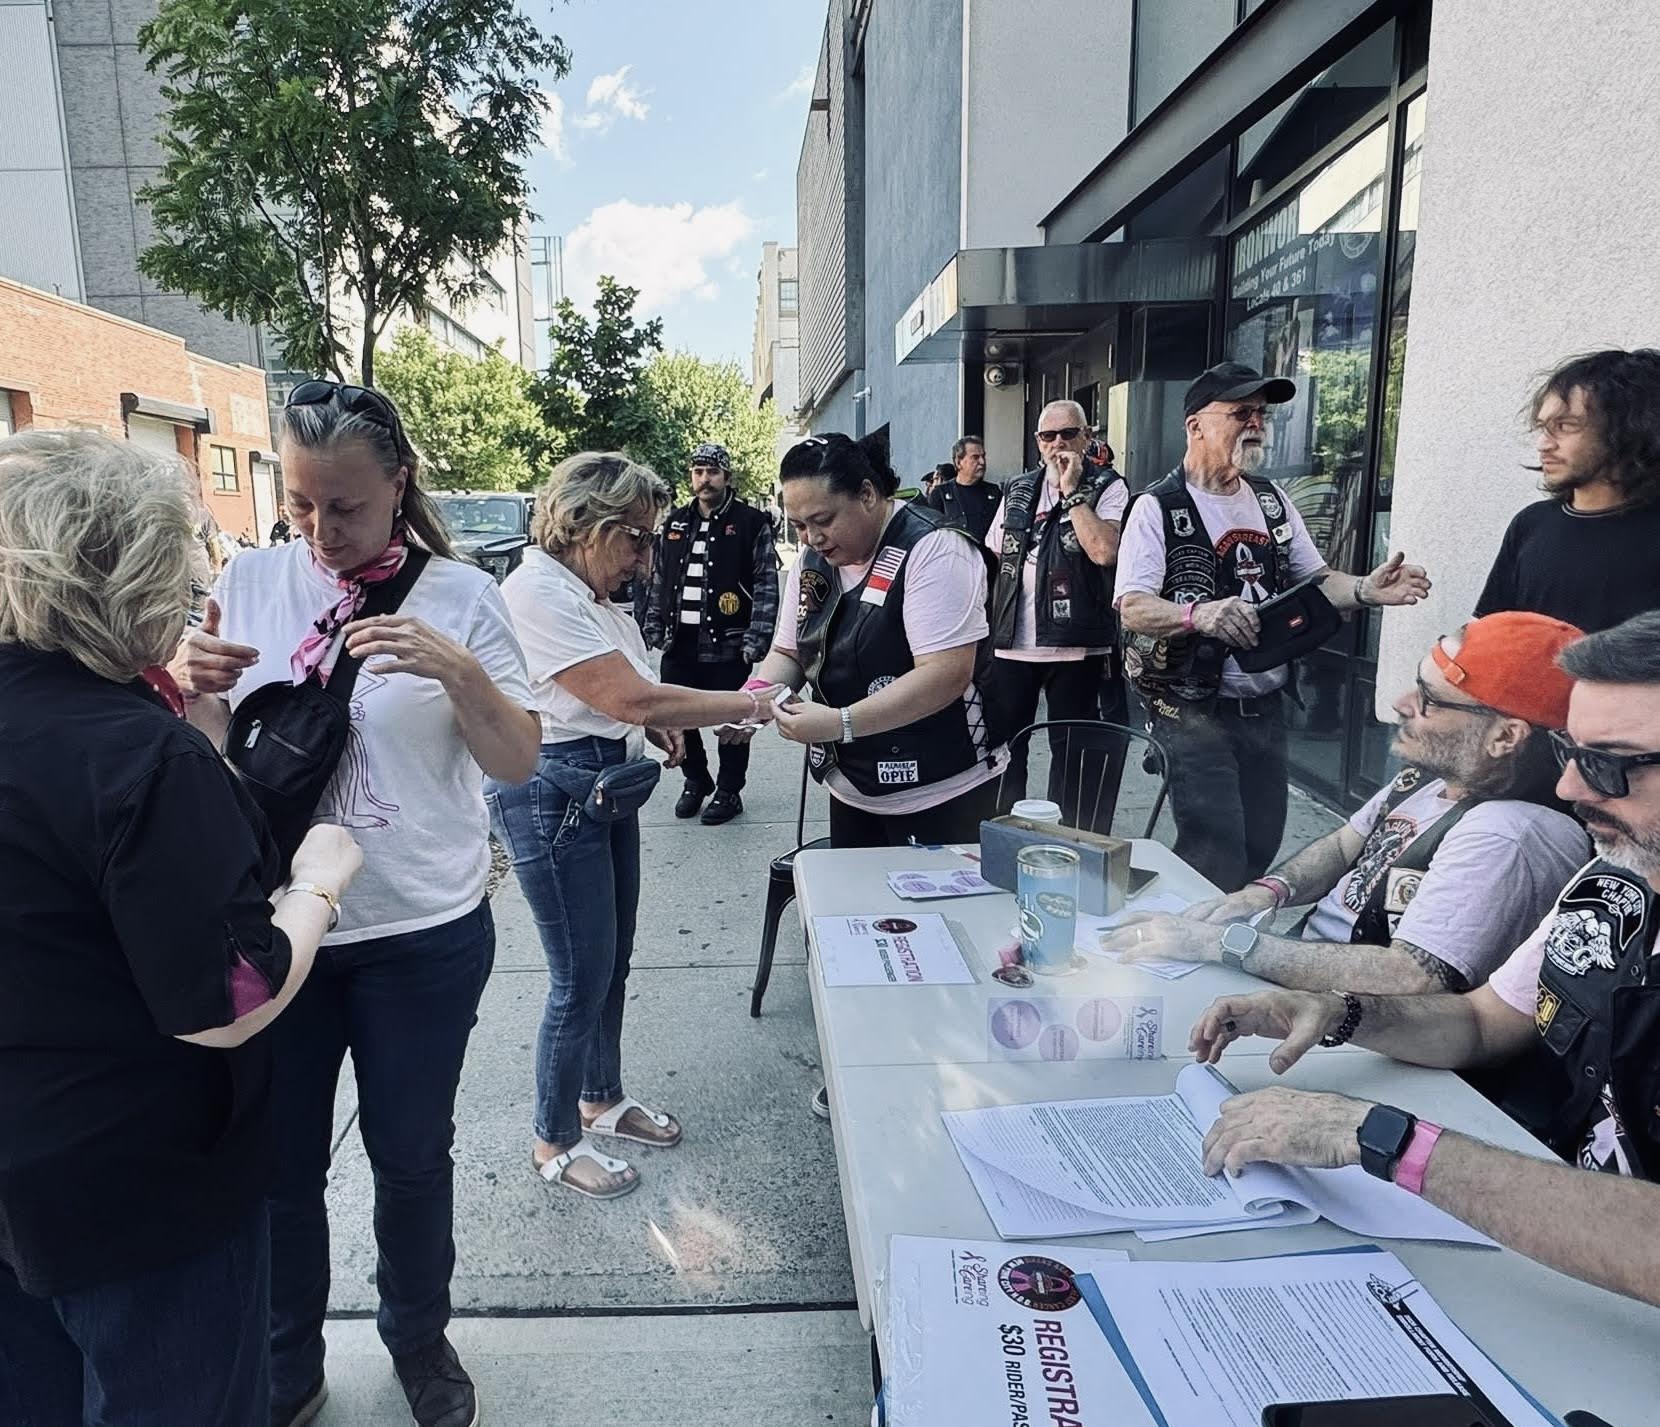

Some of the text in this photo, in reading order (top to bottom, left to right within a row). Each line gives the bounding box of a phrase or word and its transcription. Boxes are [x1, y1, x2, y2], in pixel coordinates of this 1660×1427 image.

[1260, 263, 1277, 284] Your
[1278, 247, 1305, 273] Future
[1308, 230, 1335, 255] Today
[880, 767, 917, 783] OPIE
[1596, 878, 1620, 890] NEW
[1620, 885, 1640, 903] YORK
[998, 1323, 1026, 1357] $30
